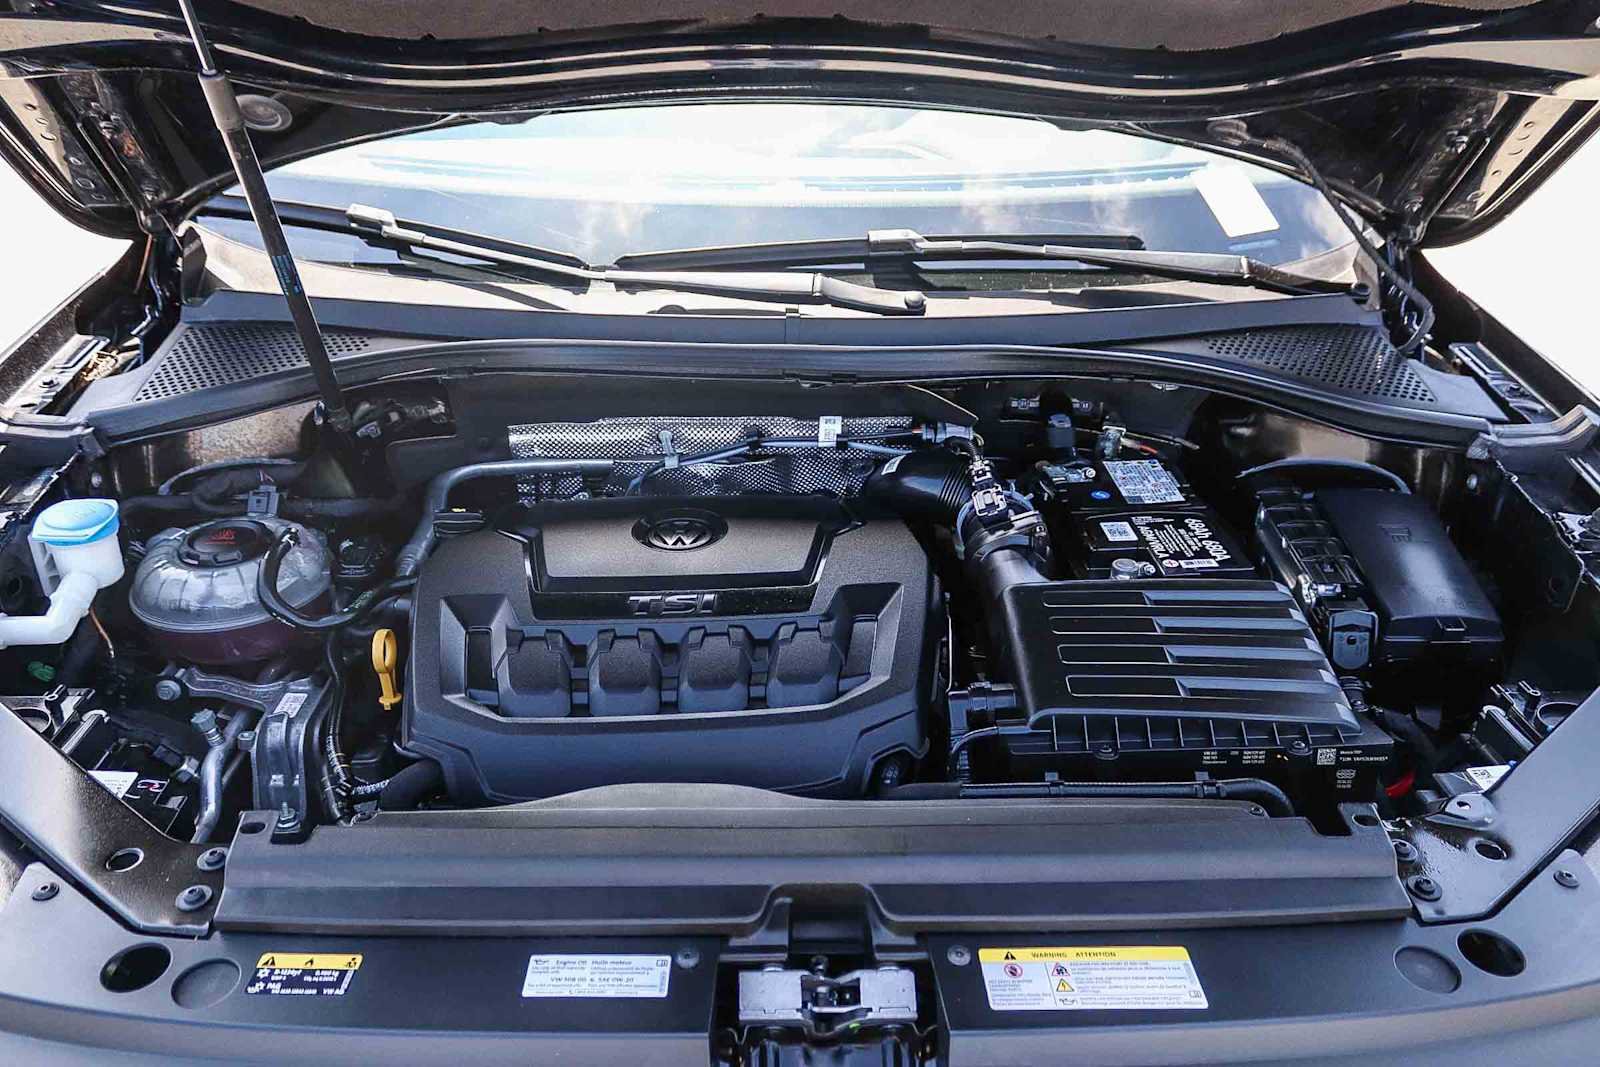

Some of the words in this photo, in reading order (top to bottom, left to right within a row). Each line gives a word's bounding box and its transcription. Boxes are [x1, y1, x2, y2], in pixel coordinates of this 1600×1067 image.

[1184, 518, 1212, 539] 68Ah
[1202, 540, 1231, 562] 680A
[627, 592, 718, 616] TSI
